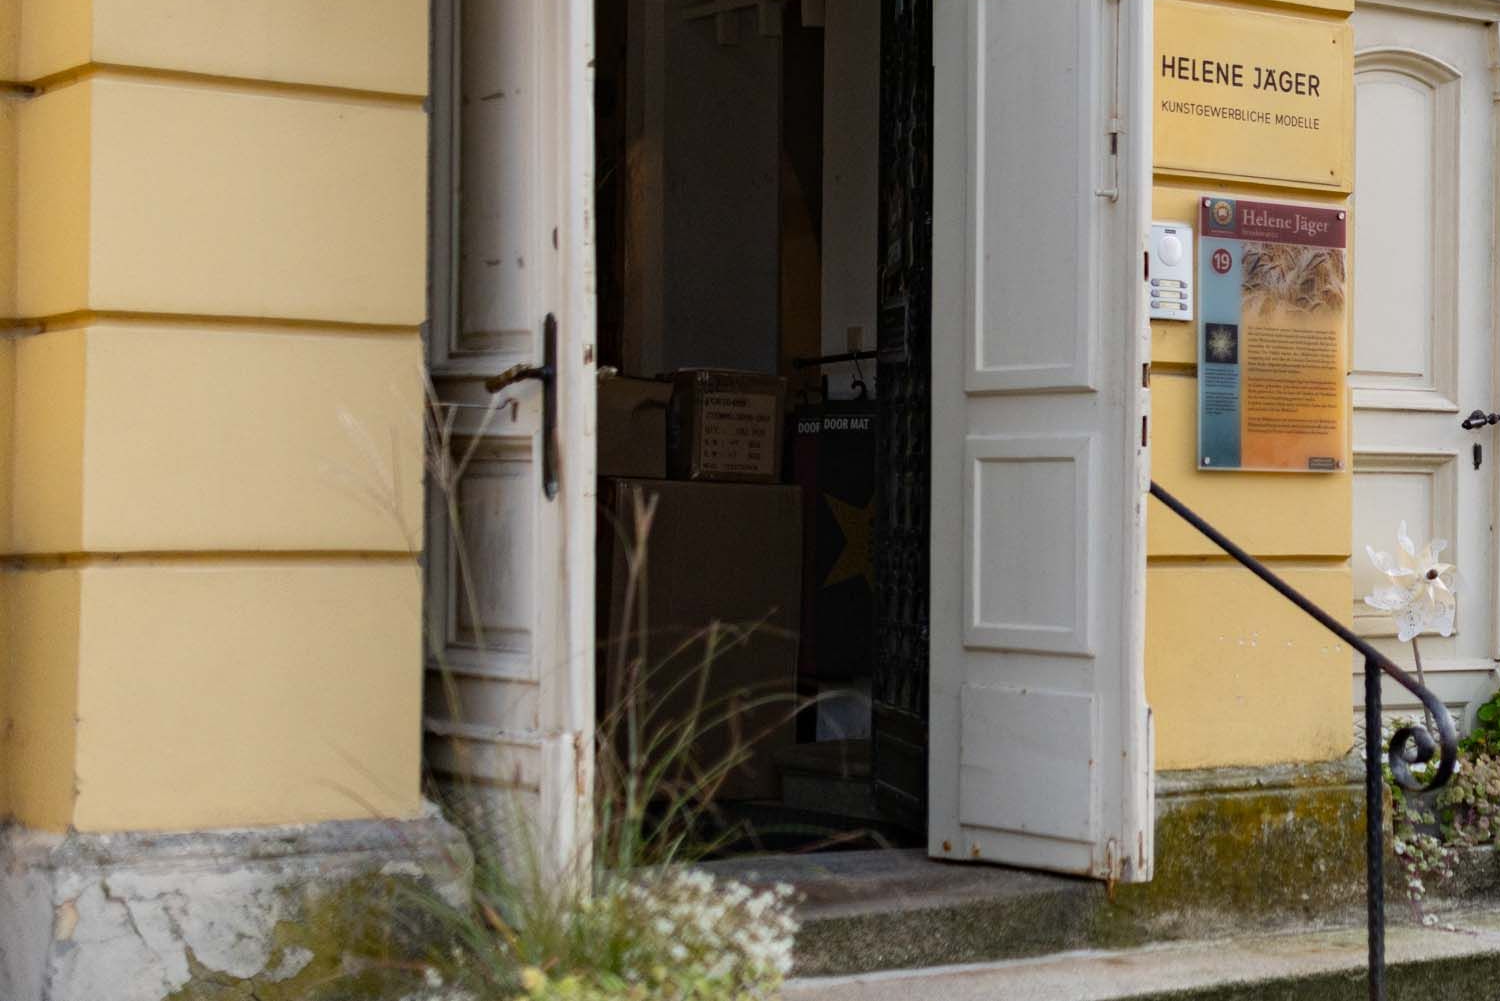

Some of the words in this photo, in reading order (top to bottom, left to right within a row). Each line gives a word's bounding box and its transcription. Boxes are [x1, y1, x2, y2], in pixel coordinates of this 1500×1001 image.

[1162, 55, 1244, 87] HELENE
[1253, 67, 1321, 97] JÄGER
[1161, 100, 1271, 124] KUNSTGEWERBLICHE
[1275, 114, 1320, 130] MODELLE
[1243, 209, 1292, 229] Helene
[1293, 214, 1328, 237] Jäger
[1214, 253, 1230, 270] 19
[824, 418, 848, 430] DOOR
[850, 418, 870, 430] MAT
